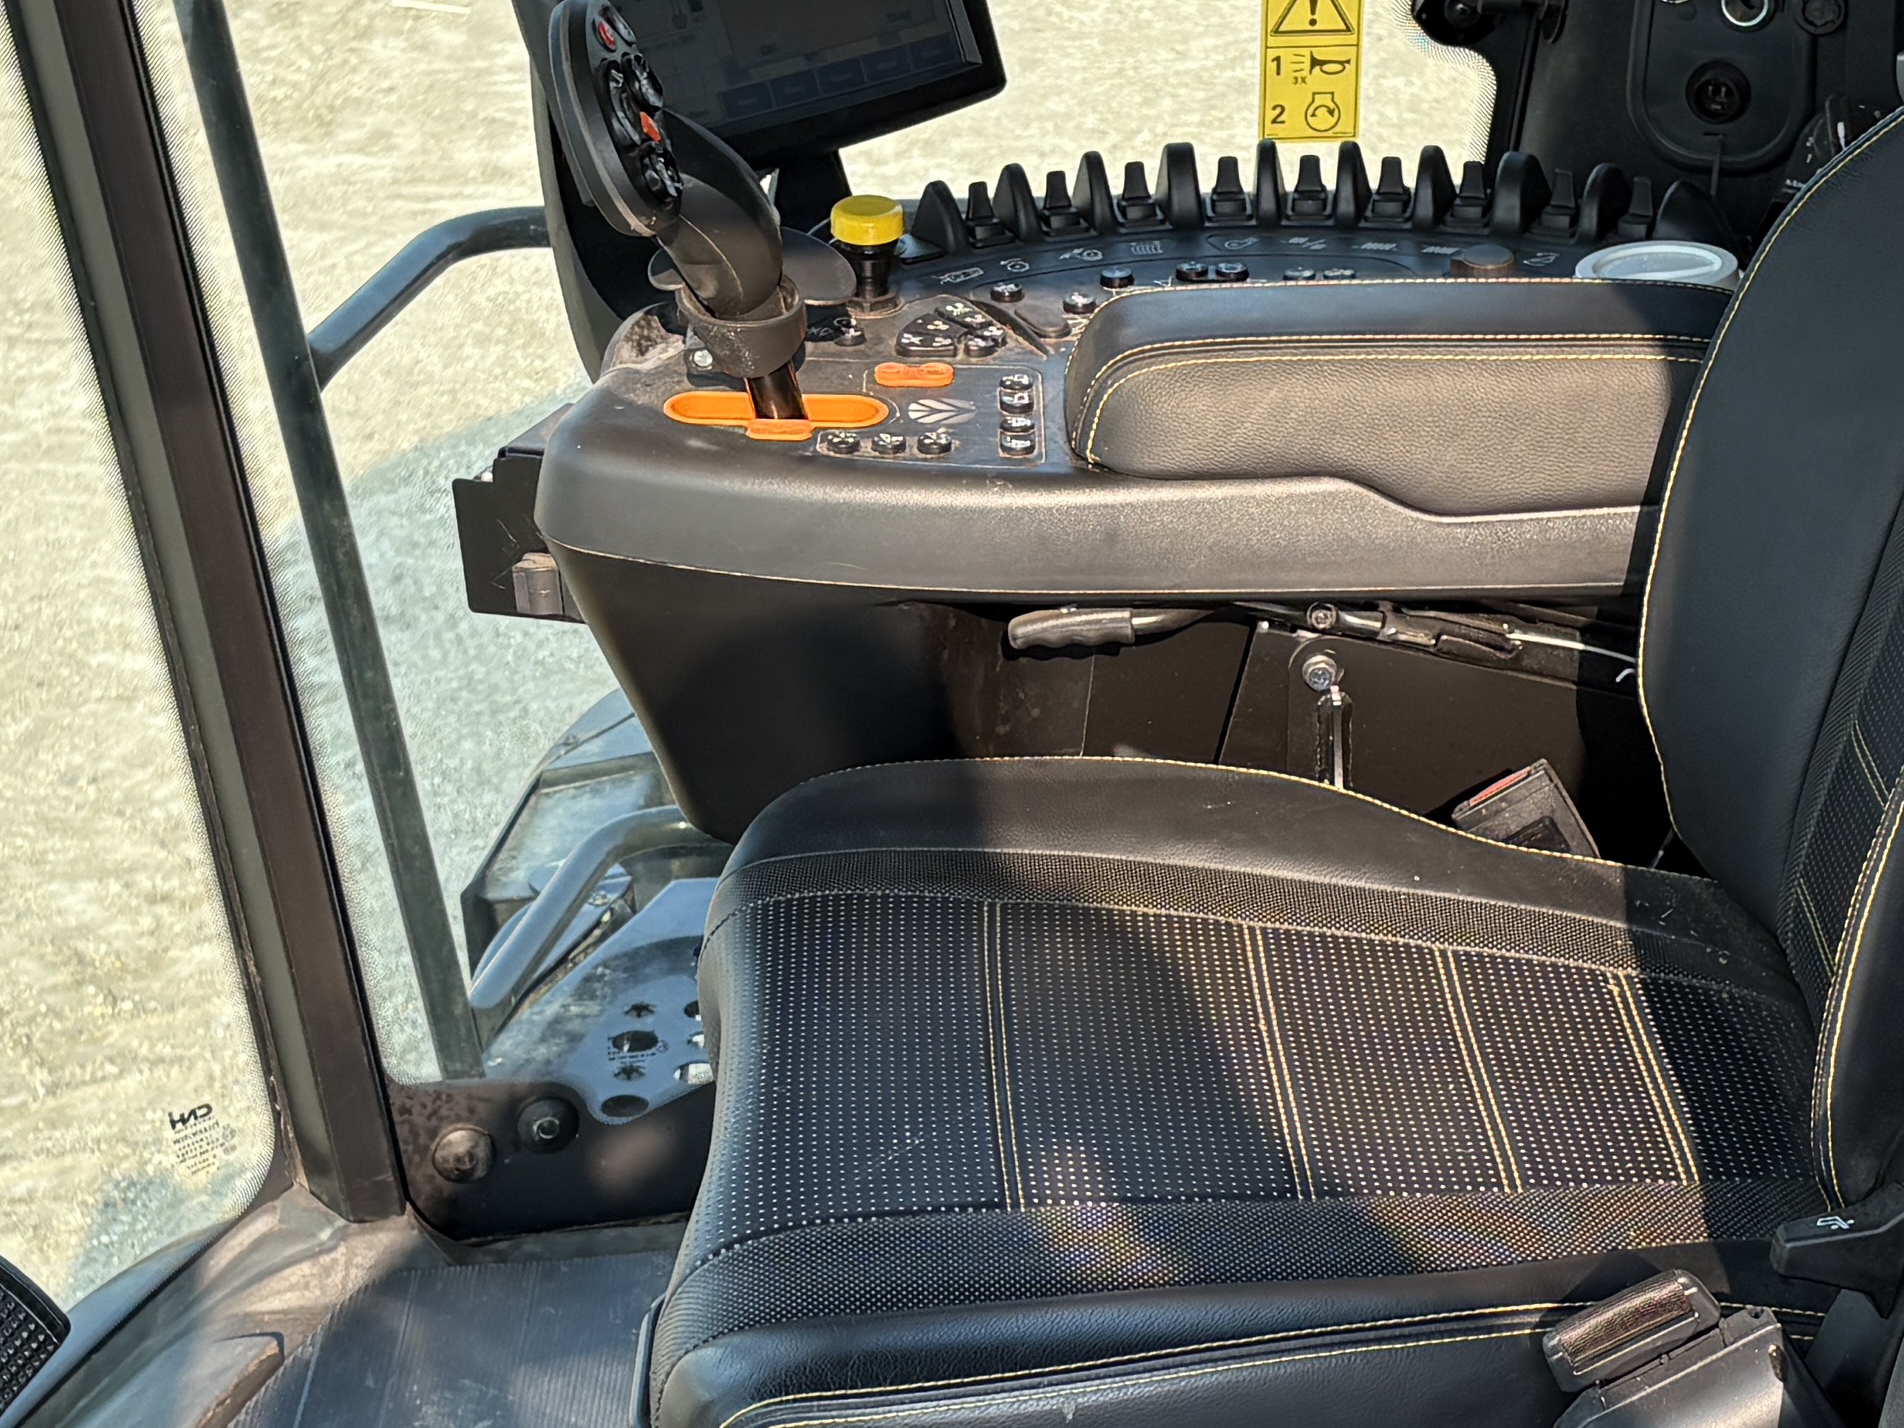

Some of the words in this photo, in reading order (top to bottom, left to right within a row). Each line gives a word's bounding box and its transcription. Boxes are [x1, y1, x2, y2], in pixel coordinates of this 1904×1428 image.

[1271, 55, 1281, 76] 1
[1292, 76, 1307, 85] 3X
[1270, 103, 1286, 125] 2
